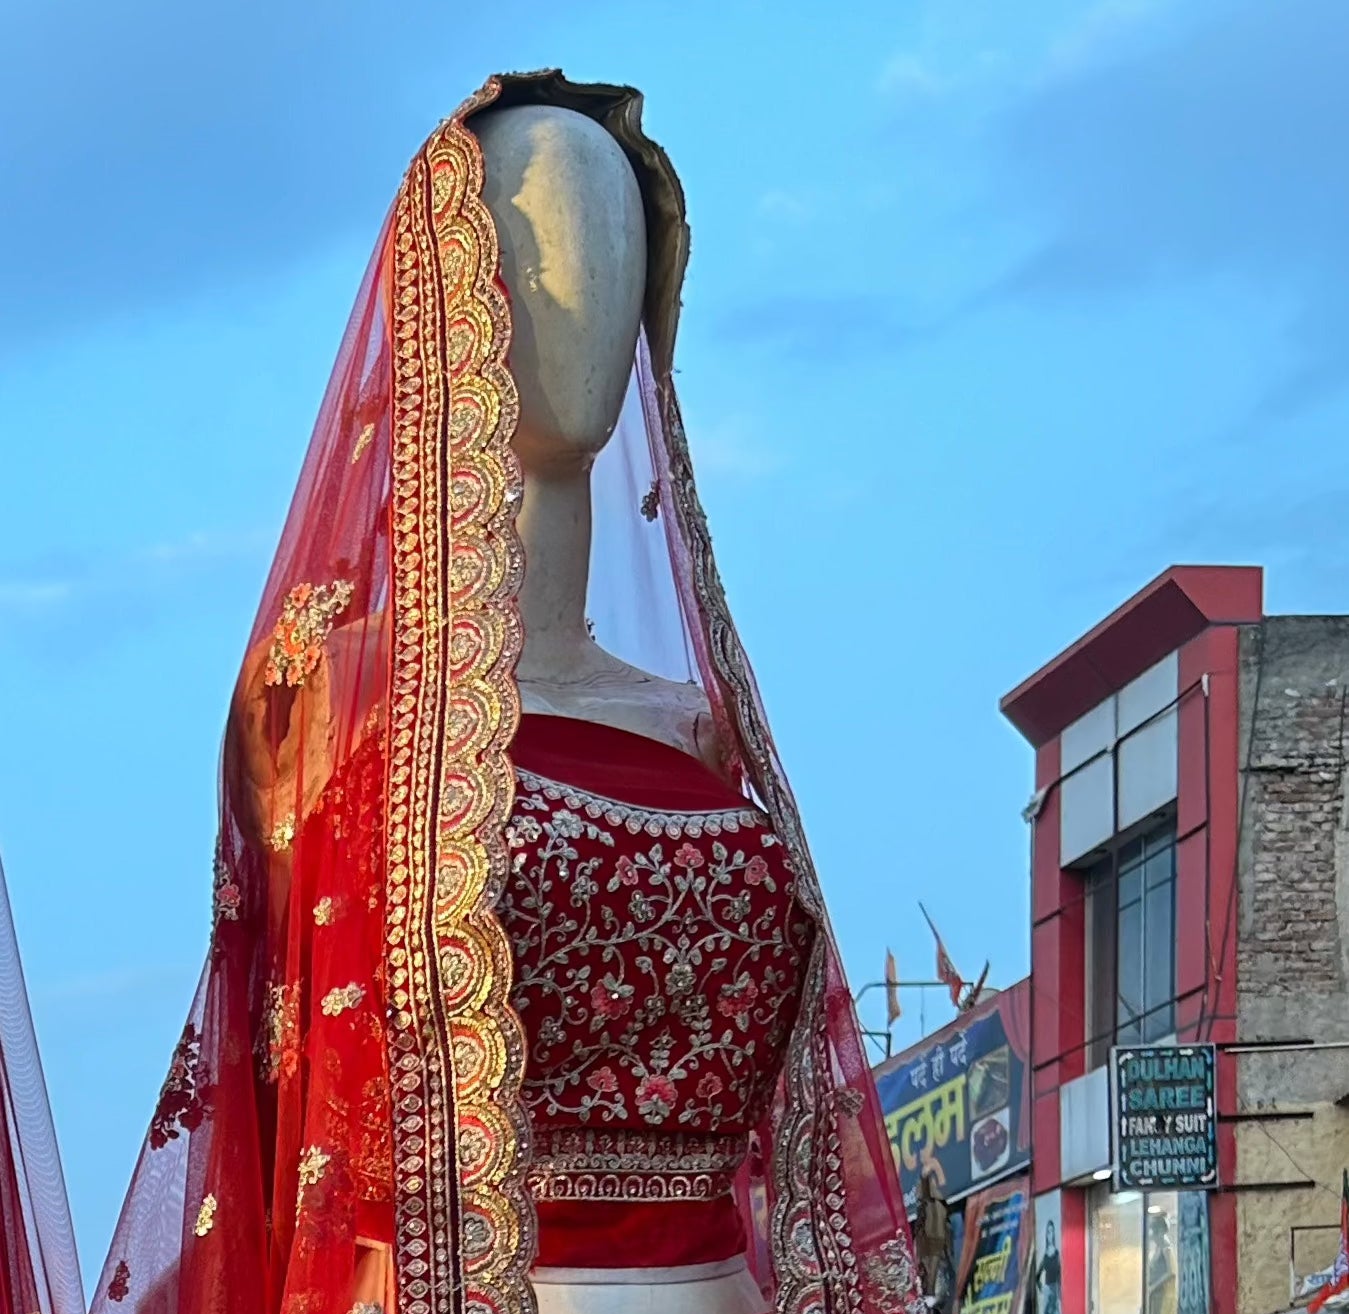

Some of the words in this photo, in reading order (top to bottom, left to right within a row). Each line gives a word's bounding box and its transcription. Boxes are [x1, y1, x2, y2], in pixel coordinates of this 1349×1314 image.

[931, 1045, 945, 1082] ही
[1127, 1056, 1206, 1081] DULHAN
[1128, 1085, 1206, 1111] SAREE
[1128, 1114, 1173, 1136] FANY
[1175, 1113, 1207, 1134] SUIT
[1129, 1136, 1207, 1157] LEHANGA
[1129, 1157, 1207, 1177] CHUNNI
